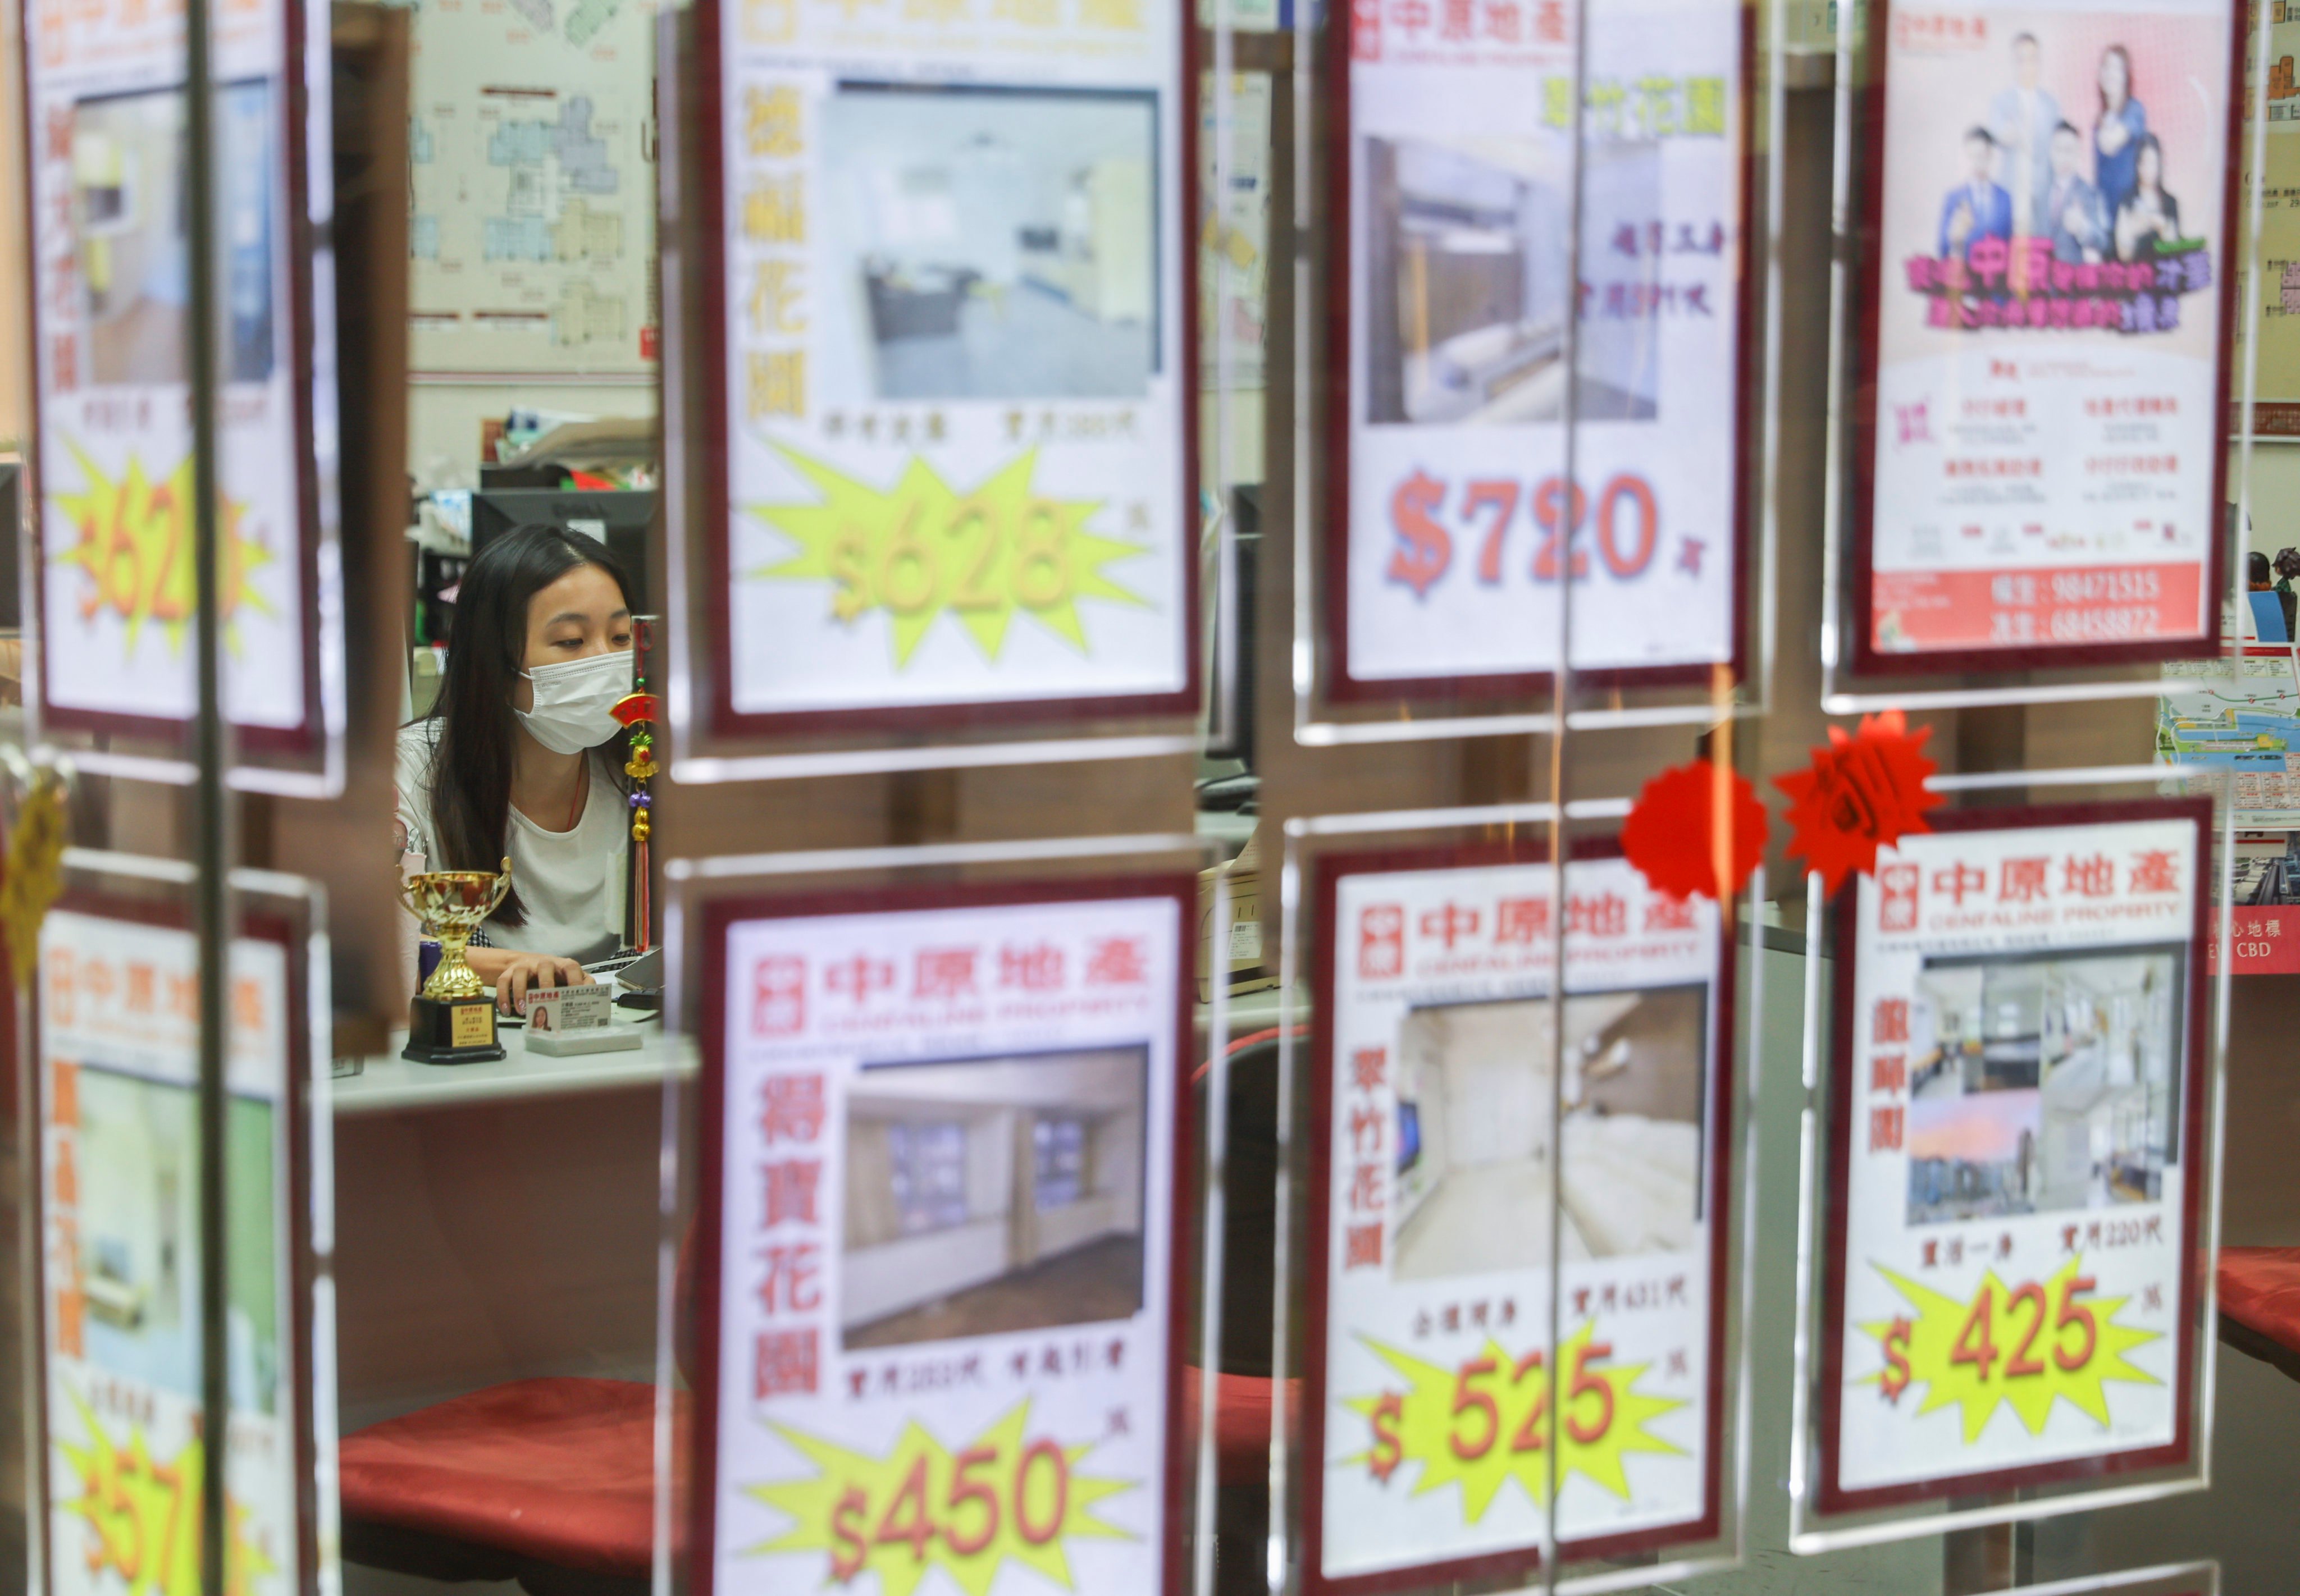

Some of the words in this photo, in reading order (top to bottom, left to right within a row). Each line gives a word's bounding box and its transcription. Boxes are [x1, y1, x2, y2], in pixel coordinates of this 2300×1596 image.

[831, 496, 1071, 624] $628
[1386, 468, 1659, 602] $720
[1931, 848, 2182, 905] 中原地產
[823, 935, 1150, 1004] 中原地產
[2237, 942, 2271, 957] CBD
[1346, 1046, 1387, 1272] 翠竹花園
[1951, 1276, 2098, 1383] 425
[1449, 1343, 1615, 1460] 525
[829, 1437, 1071, 1584] $450
